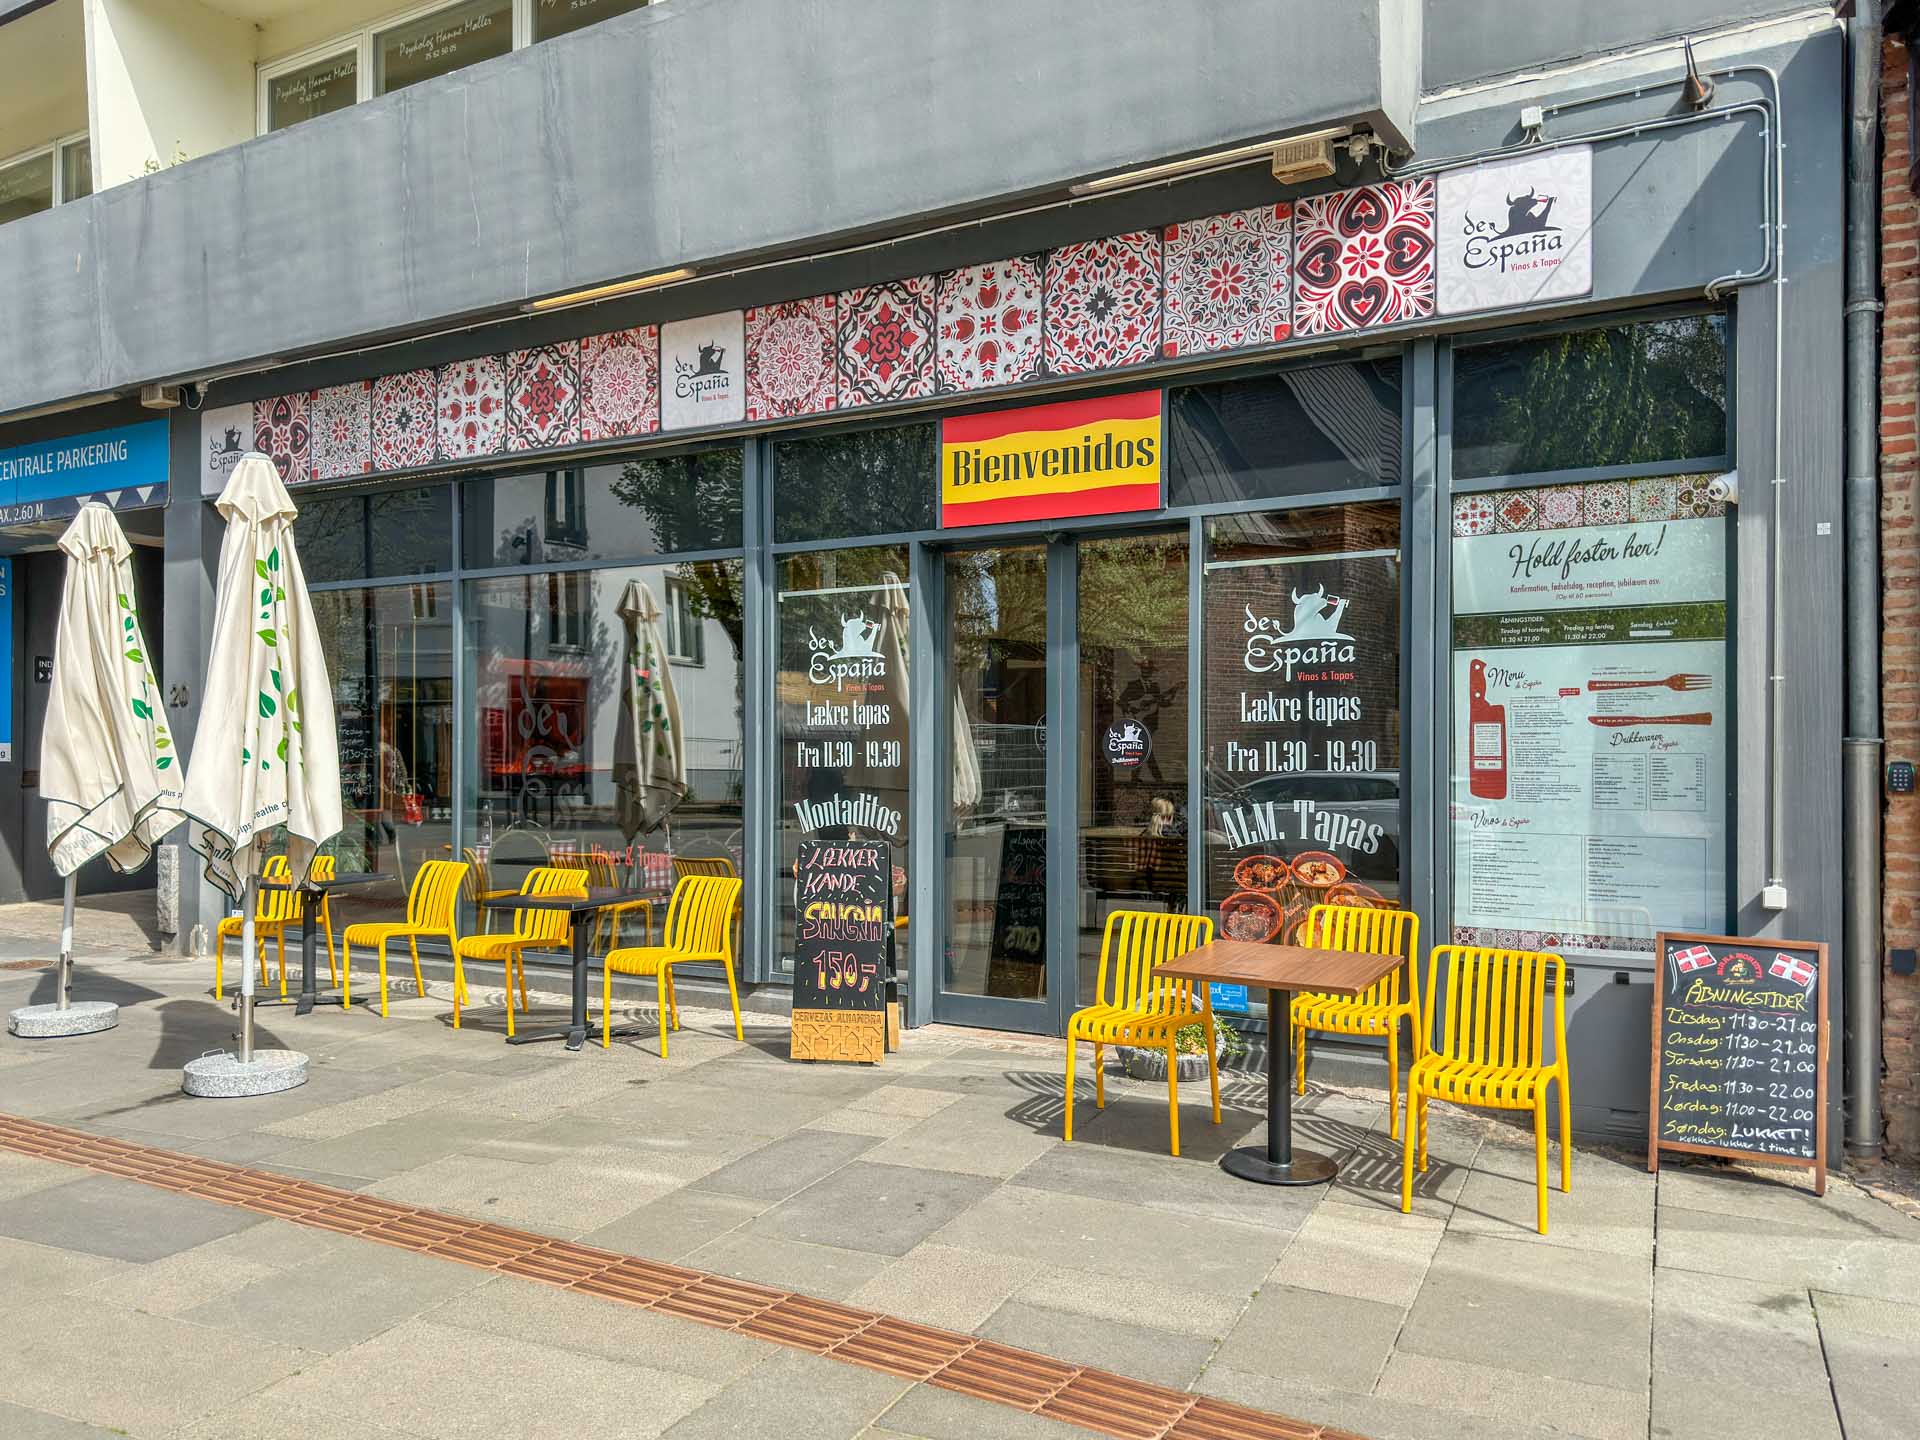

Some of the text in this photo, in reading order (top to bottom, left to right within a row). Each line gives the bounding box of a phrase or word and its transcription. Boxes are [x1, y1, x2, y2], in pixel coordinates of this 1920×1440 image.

[1463, 209, 1486, 235] de
[1463, 233, 1563, 273] España
[1510, 258, 1562, 271] Vinos & Tapas
[675, 354, 688, 374] de
[675, 374, 729, 403] España
[57, 439, 128, 471] PARKERING
[210, 450, 241, 475] Españ
[951, 432, 1155, 487] Bienvenidos
[15, 505, 33, 521] 2.60
[35, 503, 43, 517] M
[1508, 523, 1667, 580] Hold fester her!
[1510, 584, 1550, 593] Konfirmation,
[1244, 603, 1269, 633] de
[808, 625, 827, 651] de
[1244, 634, 1356, 682] España
[808, 652, 886, 692] España
[1297, 670, 1354, 682] Vinos & Tapas
[1488, 667, 1526, 688] Menu
[806, 699, 890, 729] Lækre tapas
[1240, 690, 1361, 727] Lækre tapas
[797, 741, 820, 767] Fra
[824, 741, 853, 767] 11.30
[865, 740, 901, 768] 19.30
[1108, 738, 1144, 755] España
[1227, 741, 1259, 772] Fra
[1265, 740, 1307, 772] 11.30
[1326, 740, 1377, 772] 19.30
[793, 793, 902, 836] Montaditos
[1470, 809, 1500, 829] Vinos
[1221, 800, 1384, 855] ALM. Tapas
[625, 846, 633, 867] &
[804, 872, 866, 895] KANDE
[1685, 978, 1808, 1013] ÅBNINGSTIDER
[1665, 1007, 1726, 1030] Tirsdag:
[1667, 1031, 1723, 1052] Onsdag:
[1665, 1050, 1723, 1069] Torsdag:
[1664, 1074, 1721, 1092] Fredag:
[1663, 1095, 1722, 1115] Lørdag:
[1663, 1120, 1727, 1140] Søndag:
[1769, 1143, 1797, 1155] time
